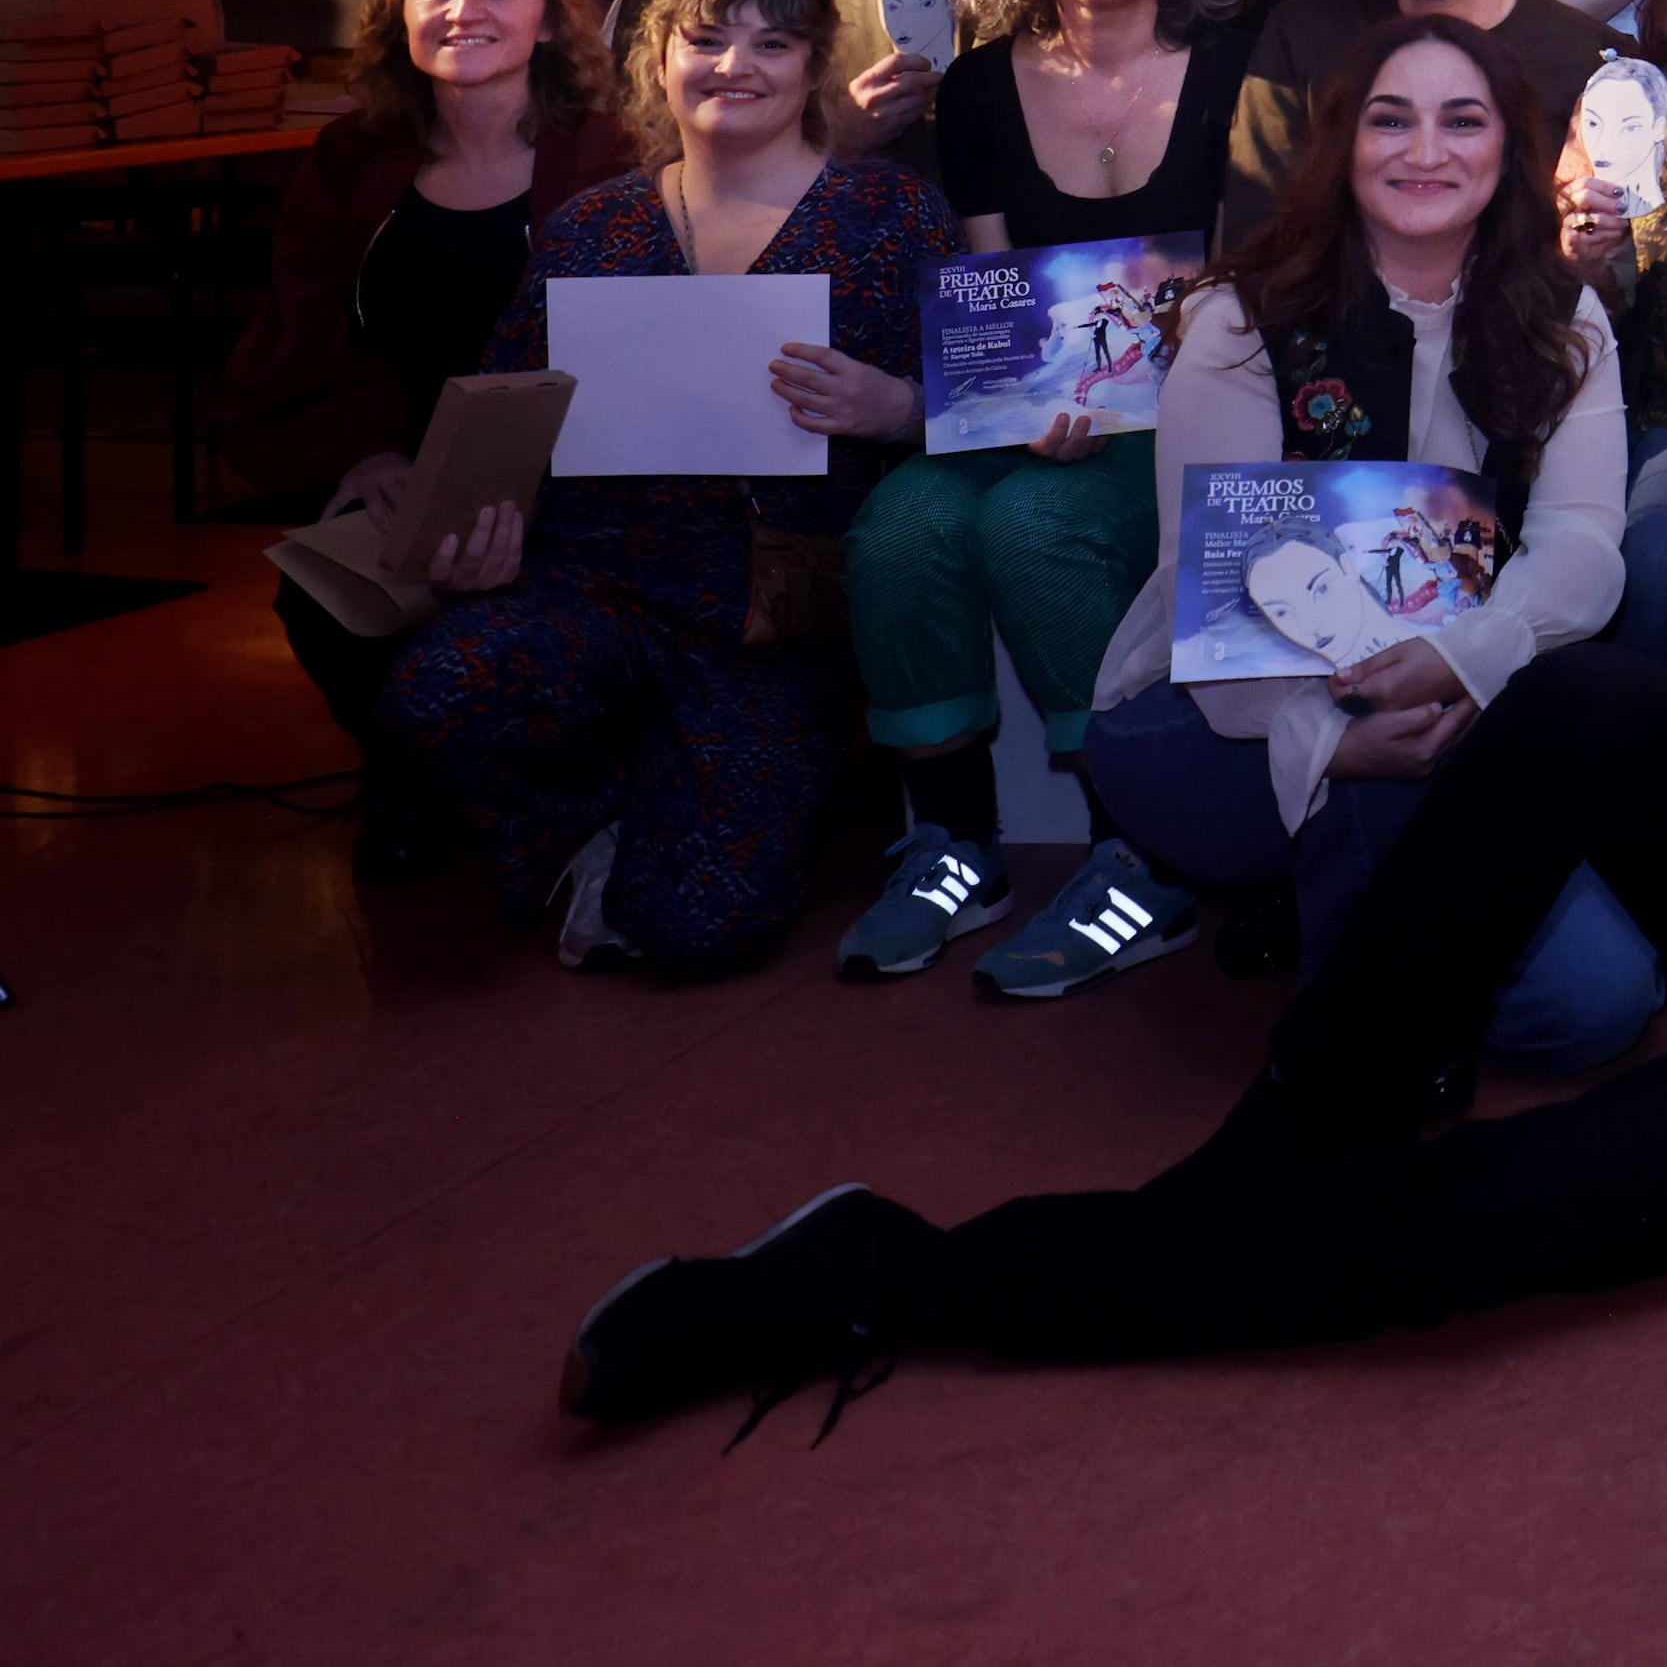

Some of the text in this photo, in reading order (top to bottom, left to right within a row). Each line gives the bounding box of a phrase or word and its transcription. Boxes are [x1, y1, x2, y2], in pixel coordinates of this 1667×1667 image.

[939, 267, 1019, 289] PREMIOS
[939, 281, 1030, 303] DE TEATRO
[969, 298, 1036, 312] María Casares
[1207, 479, 1304, 498] PREMIOS
[1207, 495, 1315, 513] DE TEATRO
